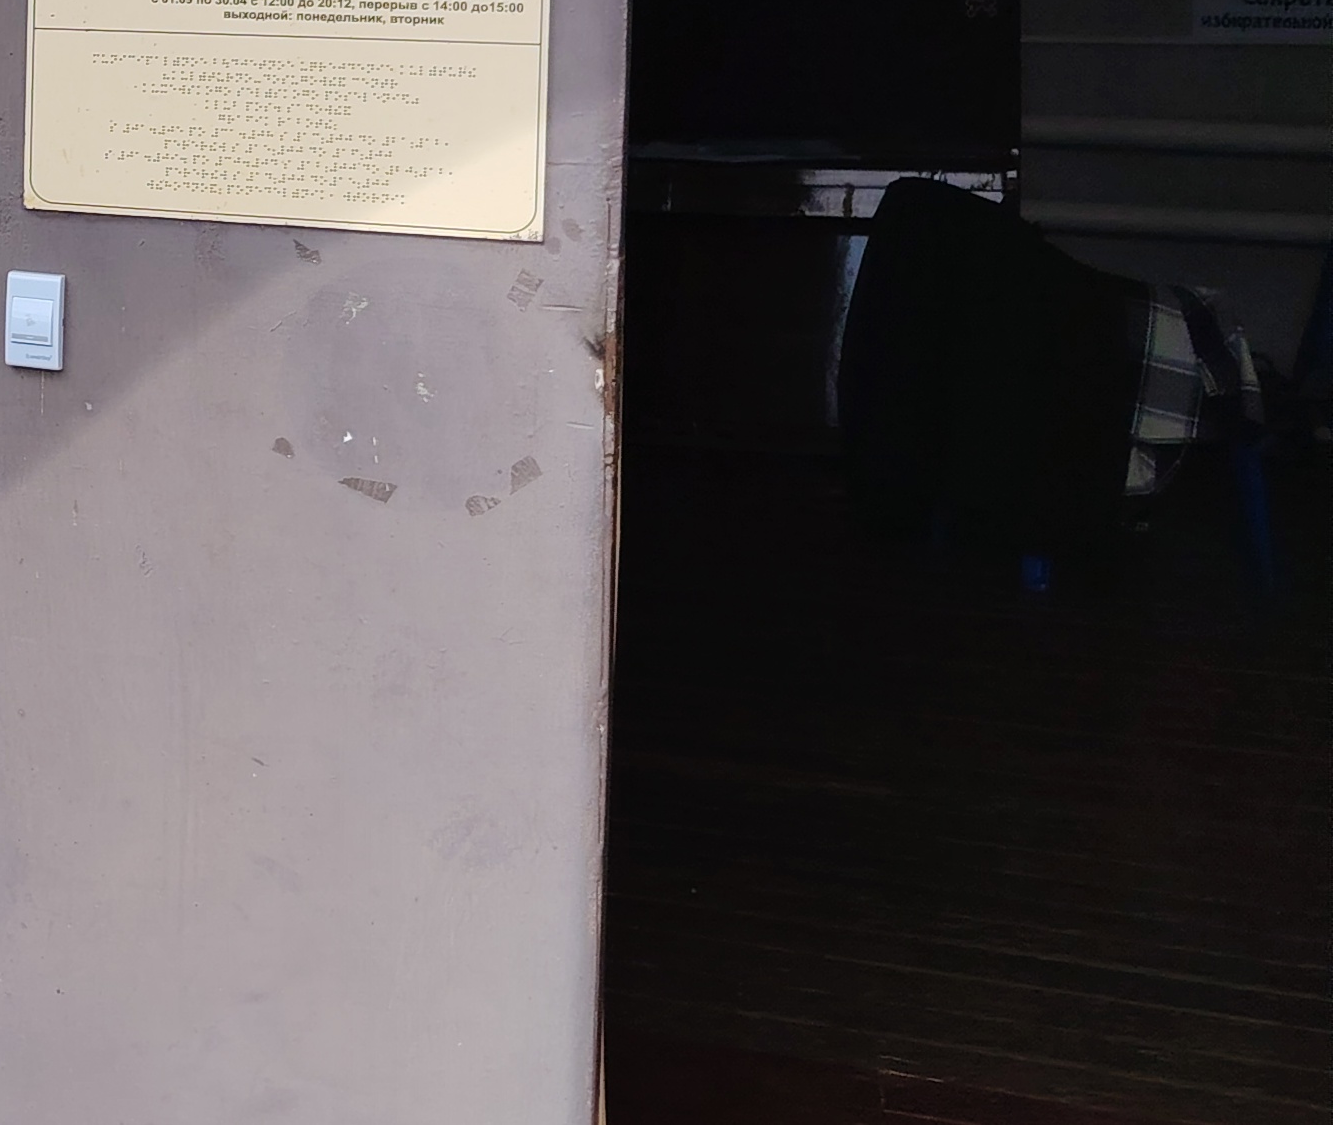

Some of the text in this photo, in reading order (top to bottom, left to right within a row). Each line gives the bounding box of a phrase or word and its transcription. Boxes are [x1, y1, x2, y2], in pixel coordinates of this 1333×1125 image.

[297, 0, 314, 8] до
[358, 0, 418, 12] перерыв
[421, 2, 429, 11] с
[433, 1, 468, 11] 14:00
[223, 11, 445, 26] выходной: понедельник, вторник
